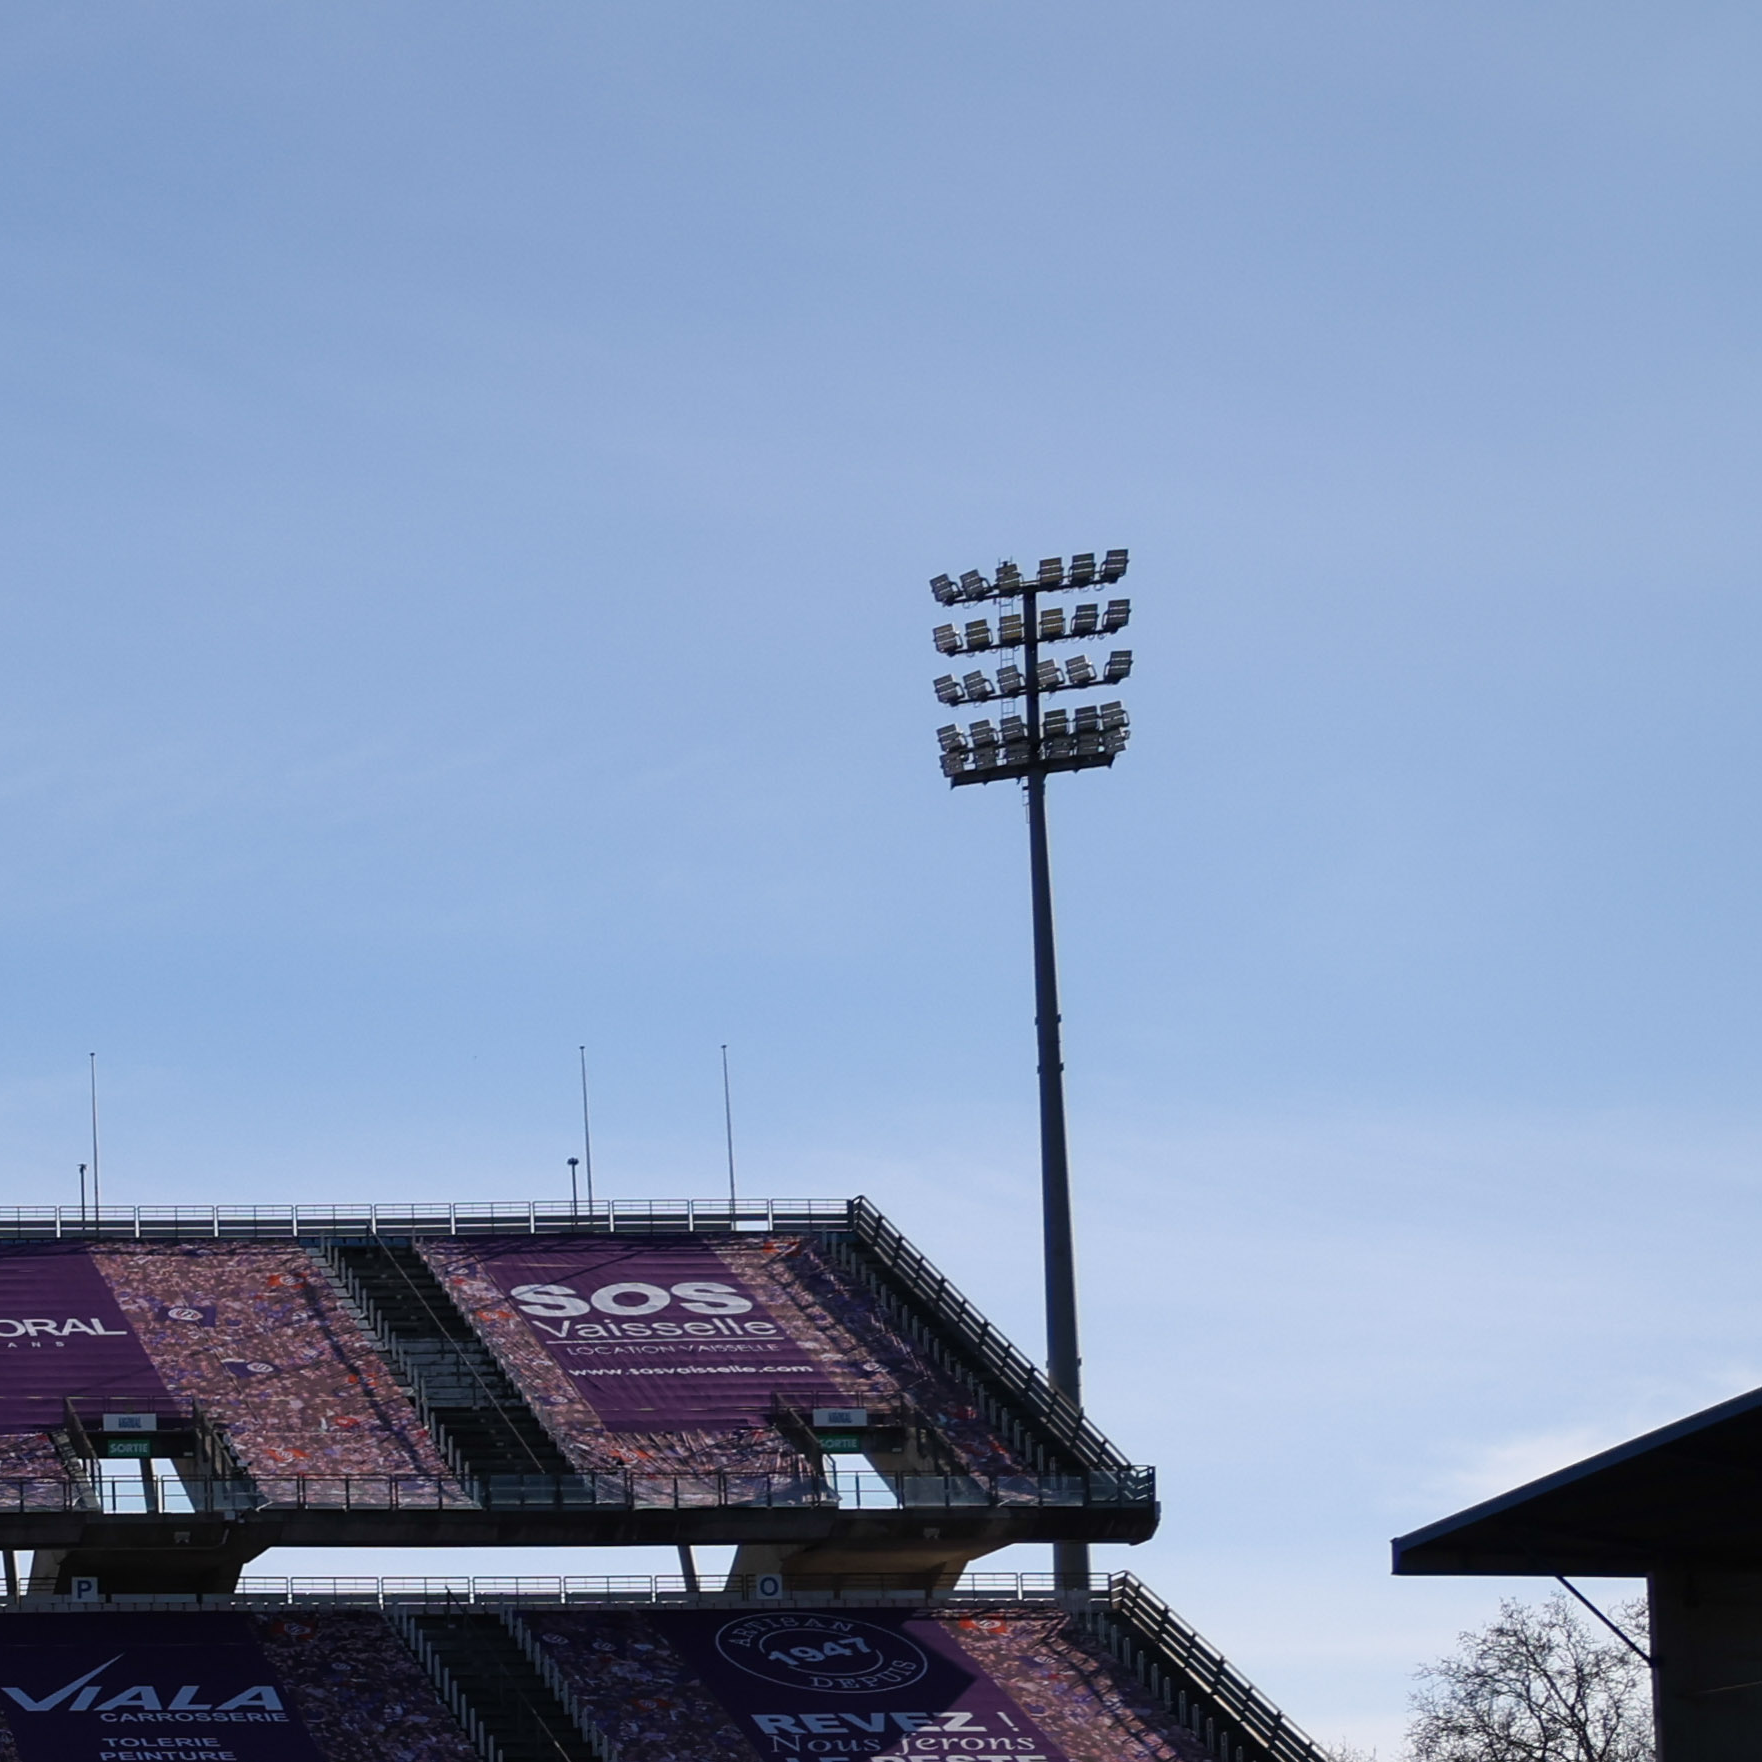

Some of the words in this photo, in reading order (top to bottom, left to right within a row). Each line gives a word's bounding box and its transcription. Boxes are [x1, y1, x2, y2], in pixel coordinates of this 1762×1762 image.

[510, 1282, 754, 1317] SOS
[532, 1318, 777, 1338] Vaisselle
[566, 1345, 677, 1356] LOCATION
[568, 1364, 814, 1377] www.sosvaisselle.com
[109, 1443, 148, 1453] SORTIE
[77, 1580, 93, 1599] P
[729, 1613, 855, 1648] ARTISAN
[768, 1636, 875, 1670] 1947
[1, 1651, 284, 1712] VIALA
[813, 1658, 918, 1690] DEPUIS
[99, 1712, 290, 1723] CARROSSERIE
[751, 1711, 988, 1735] REVEZ
[101, 1736, 222, 1748] TOLERIE
[770, 1734, 881, 1754] Nous
[895, 1732, 1036, 1756] ferons
[99, 1750, 238, 1761] PEINTURE
